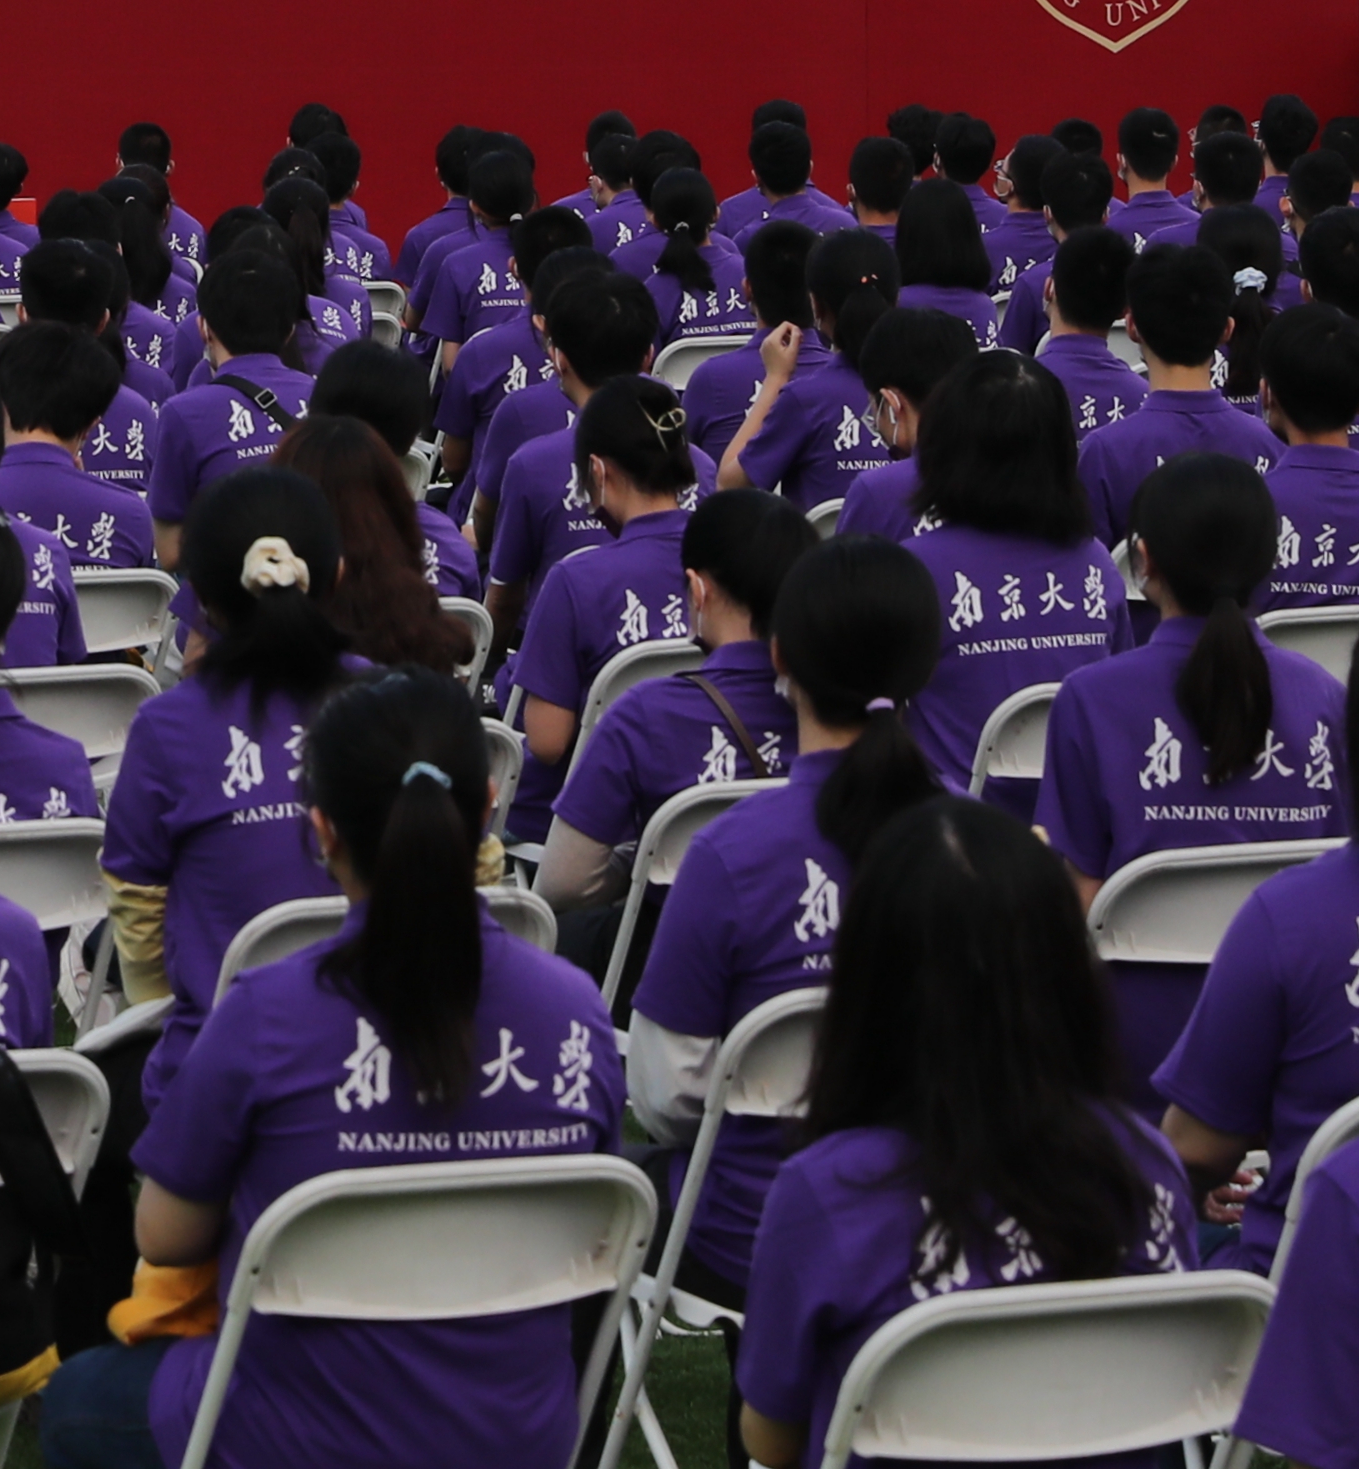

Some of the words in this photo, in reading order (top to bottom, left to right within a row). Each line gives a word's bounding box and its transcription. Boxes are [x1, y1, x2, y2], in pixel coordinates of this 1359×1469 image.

[679, 288, 751, 325] 南京大
[92, 420, 144, 460] 大學
[949, 565, 1106, 631] 南京大學
[958, 638, 1027, 655] NANJING
[1032, 634, 1105, 648] UNIVERSITY
[1139, 718, 1334, 790] 南大學
[1145, 806, 1229, 820] NANJING
[1235, 805, 1330, 821] UNIVERSITY
[335, 1017, 592, 1112] 南大學
[339, 1133, 450, 1151] NANJING
[458, 1123, 587, 1150] UNIVERSITY
